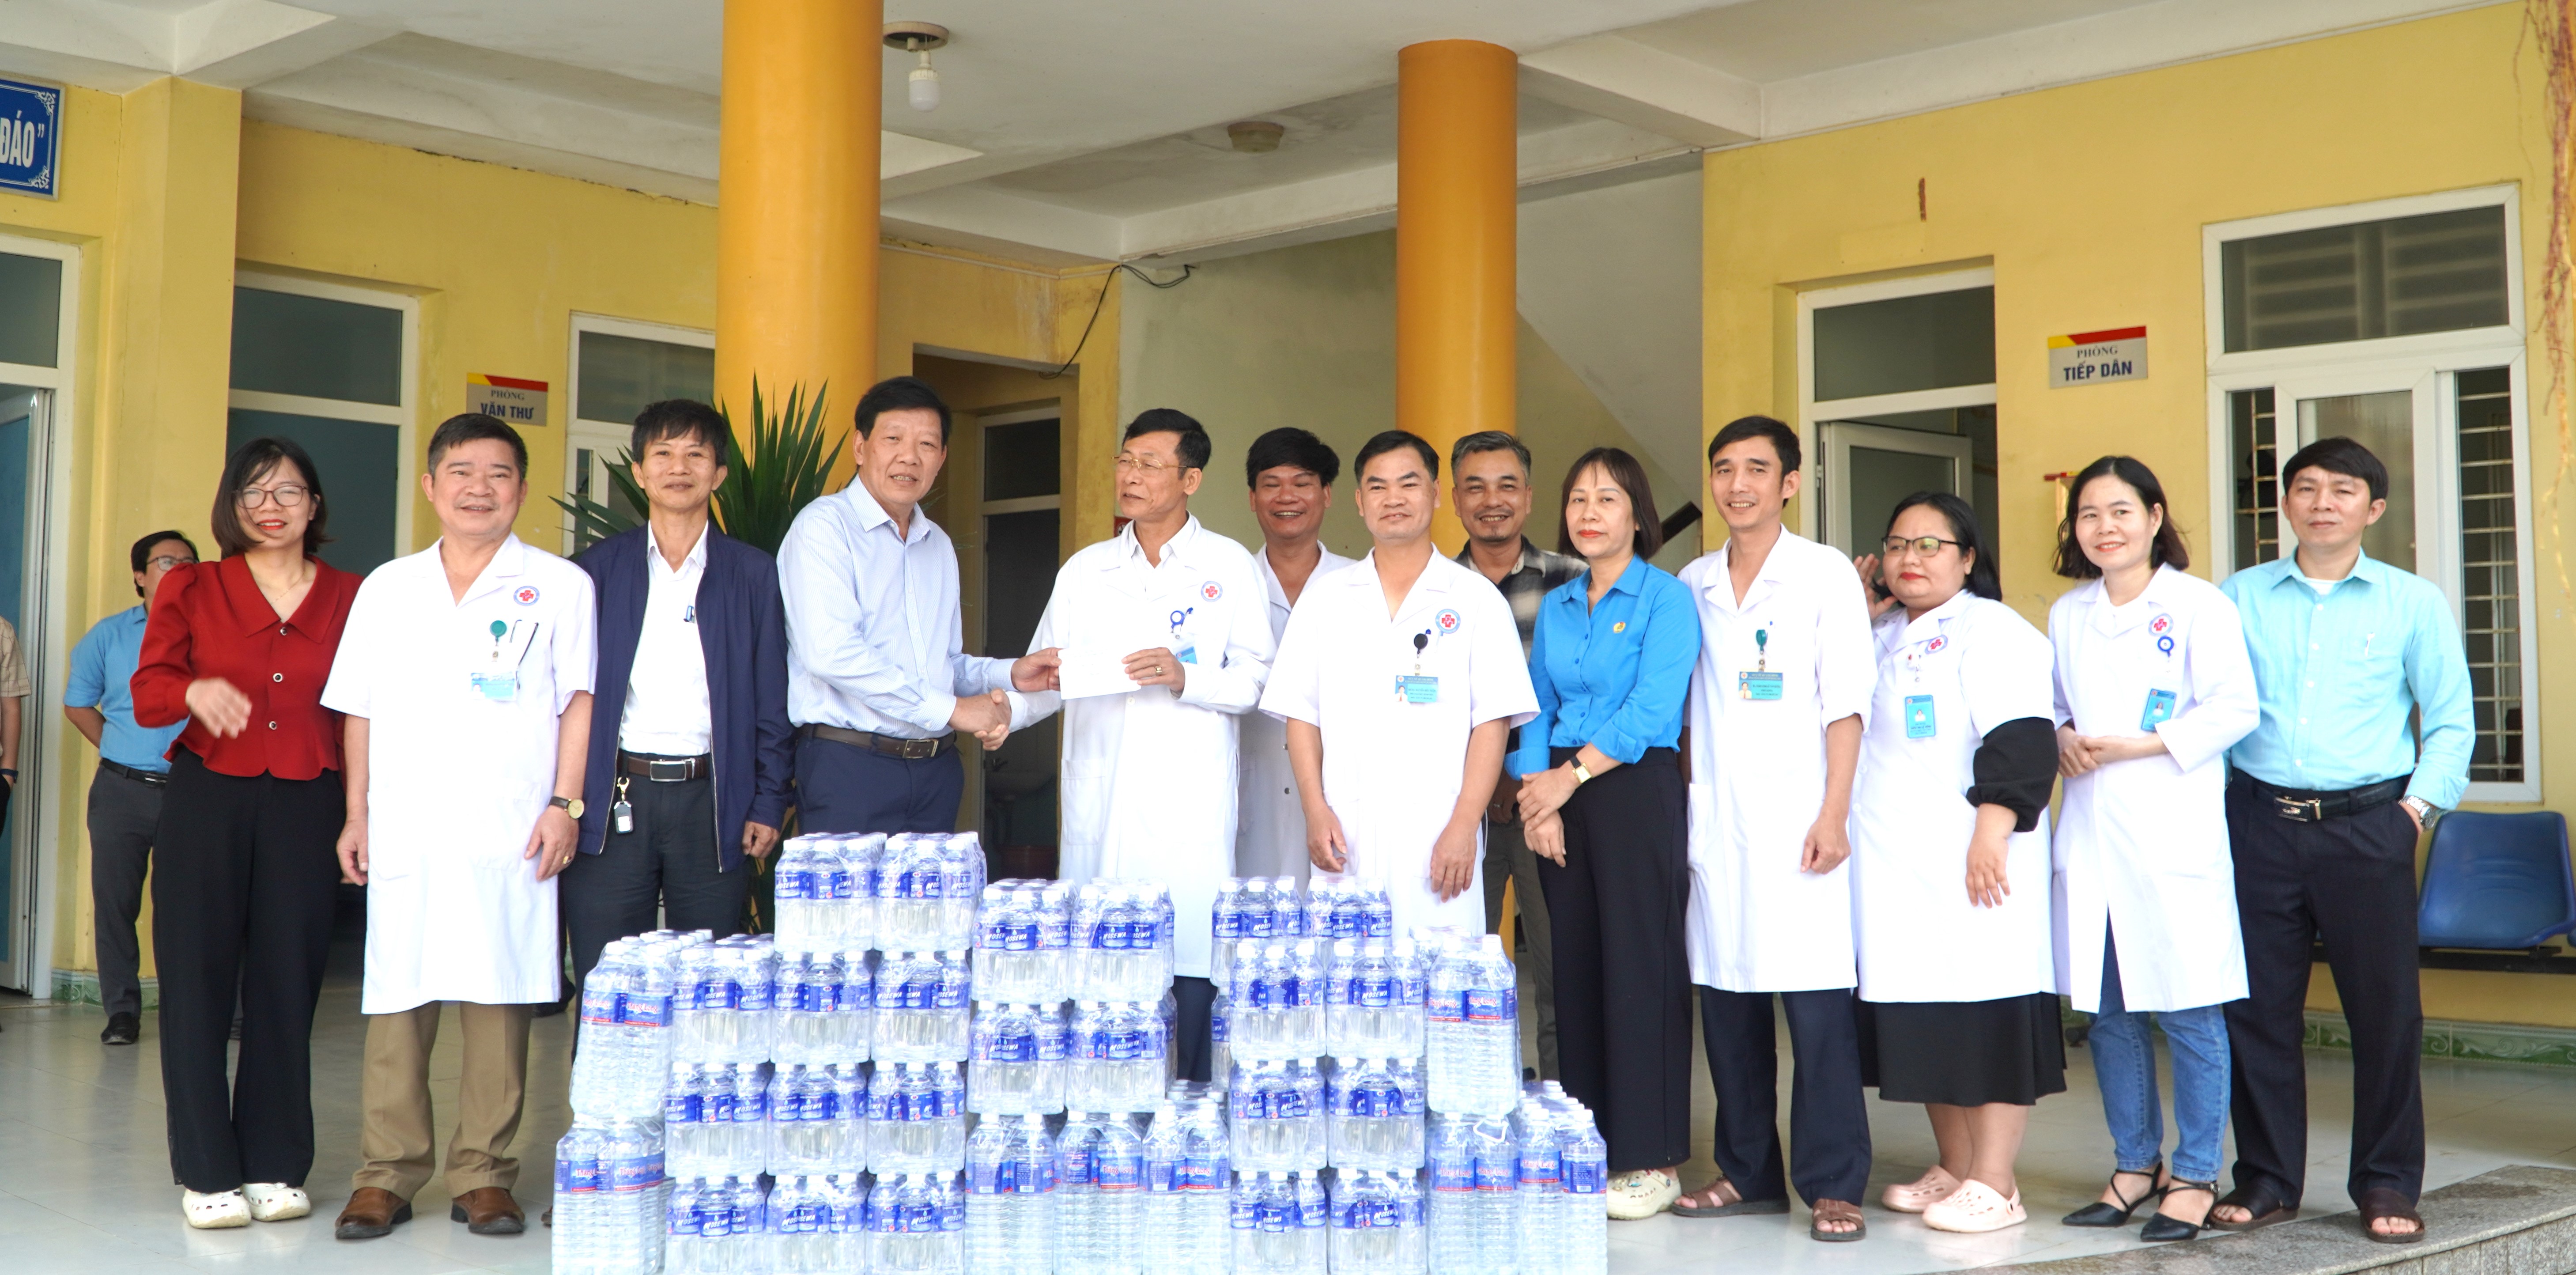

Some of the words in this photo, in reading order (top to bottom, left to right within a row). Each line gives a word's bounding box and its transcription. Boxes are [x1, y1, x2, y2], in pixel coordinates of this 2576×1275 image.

[2063, 360, 2095, 381] TIẾP
[2101, 358, 2132, 378] DÂN
[480, 401, 505, 416] VĂN
[510, 406, 534, 420] THƯ
[1362, 990, 1387, 999] MOSEWA
[703, 1219, 729, 1230] MOSEWA
